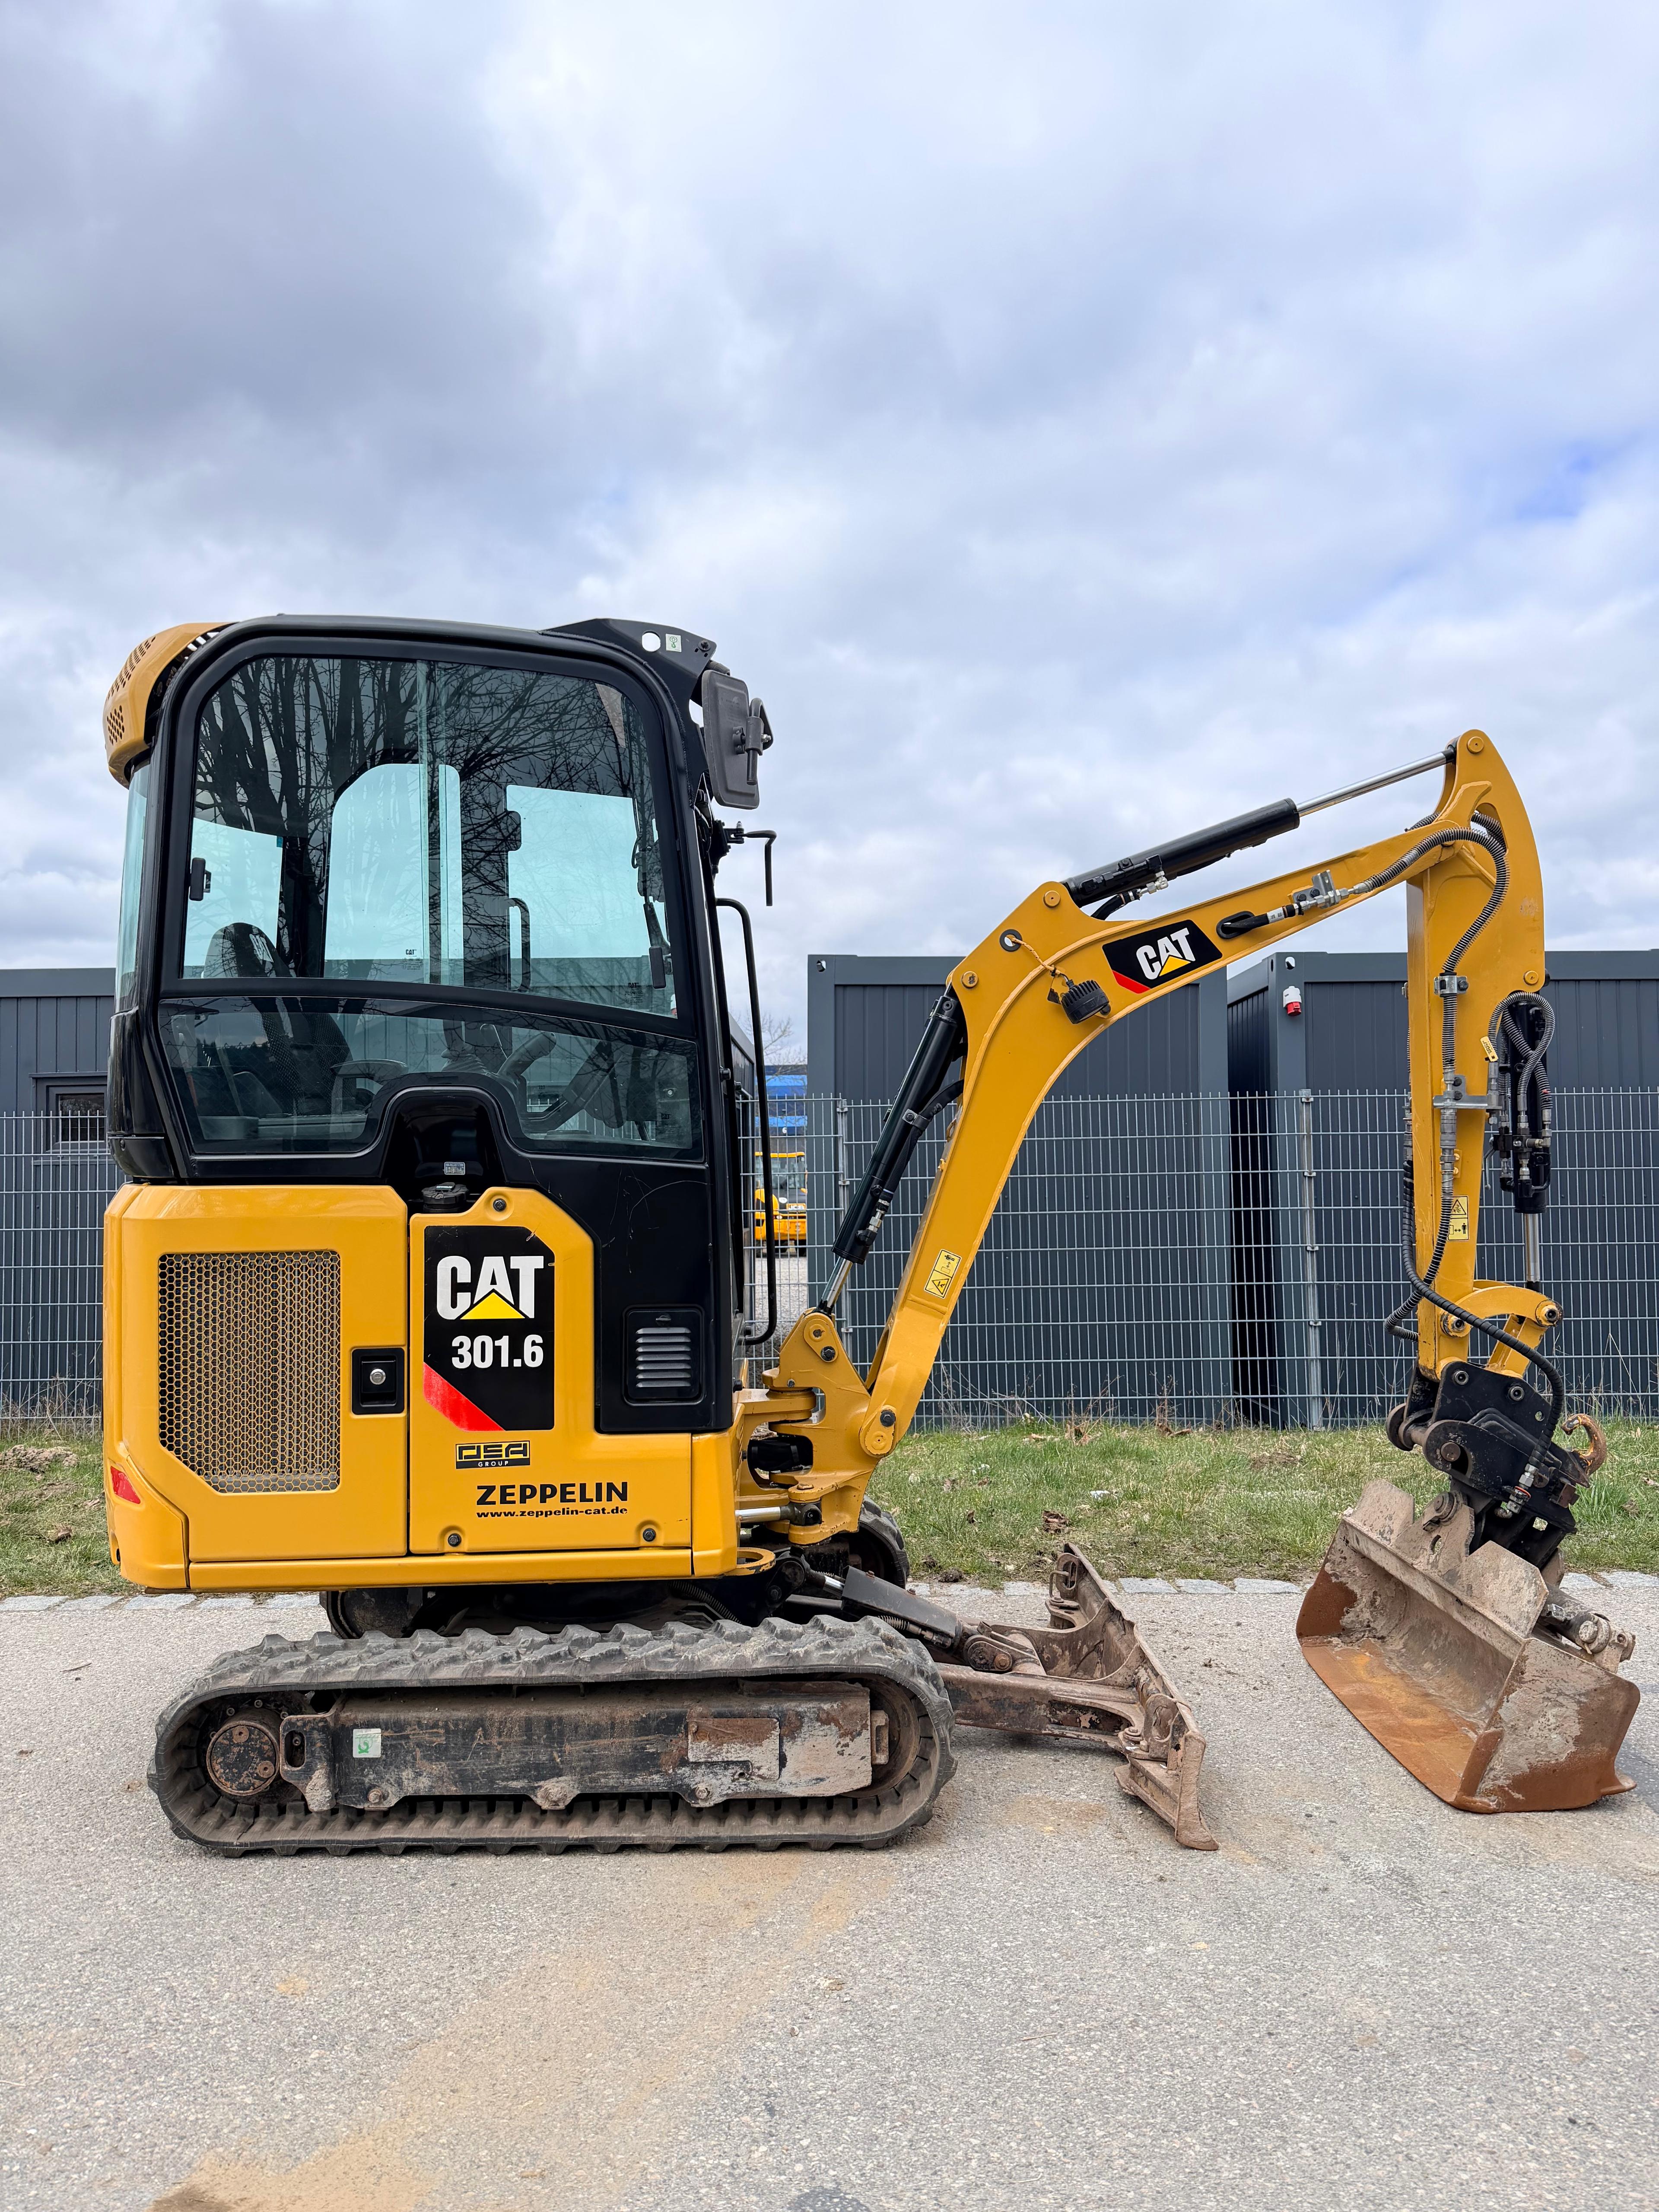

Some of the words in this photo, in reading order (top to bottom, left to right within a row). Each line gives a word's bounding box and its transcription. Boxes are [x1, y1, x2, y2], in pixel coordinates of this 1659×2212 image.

[1136, 927, 1196, 980] CAT
[437, 1255, 544, 1320] CAT
[451, 1334, 543, 1369] 301.6
[476, 1481, 628, 1506] ZEPPELIN
[477, 1506, 628, 1518] www.zeppelin-cat.de
